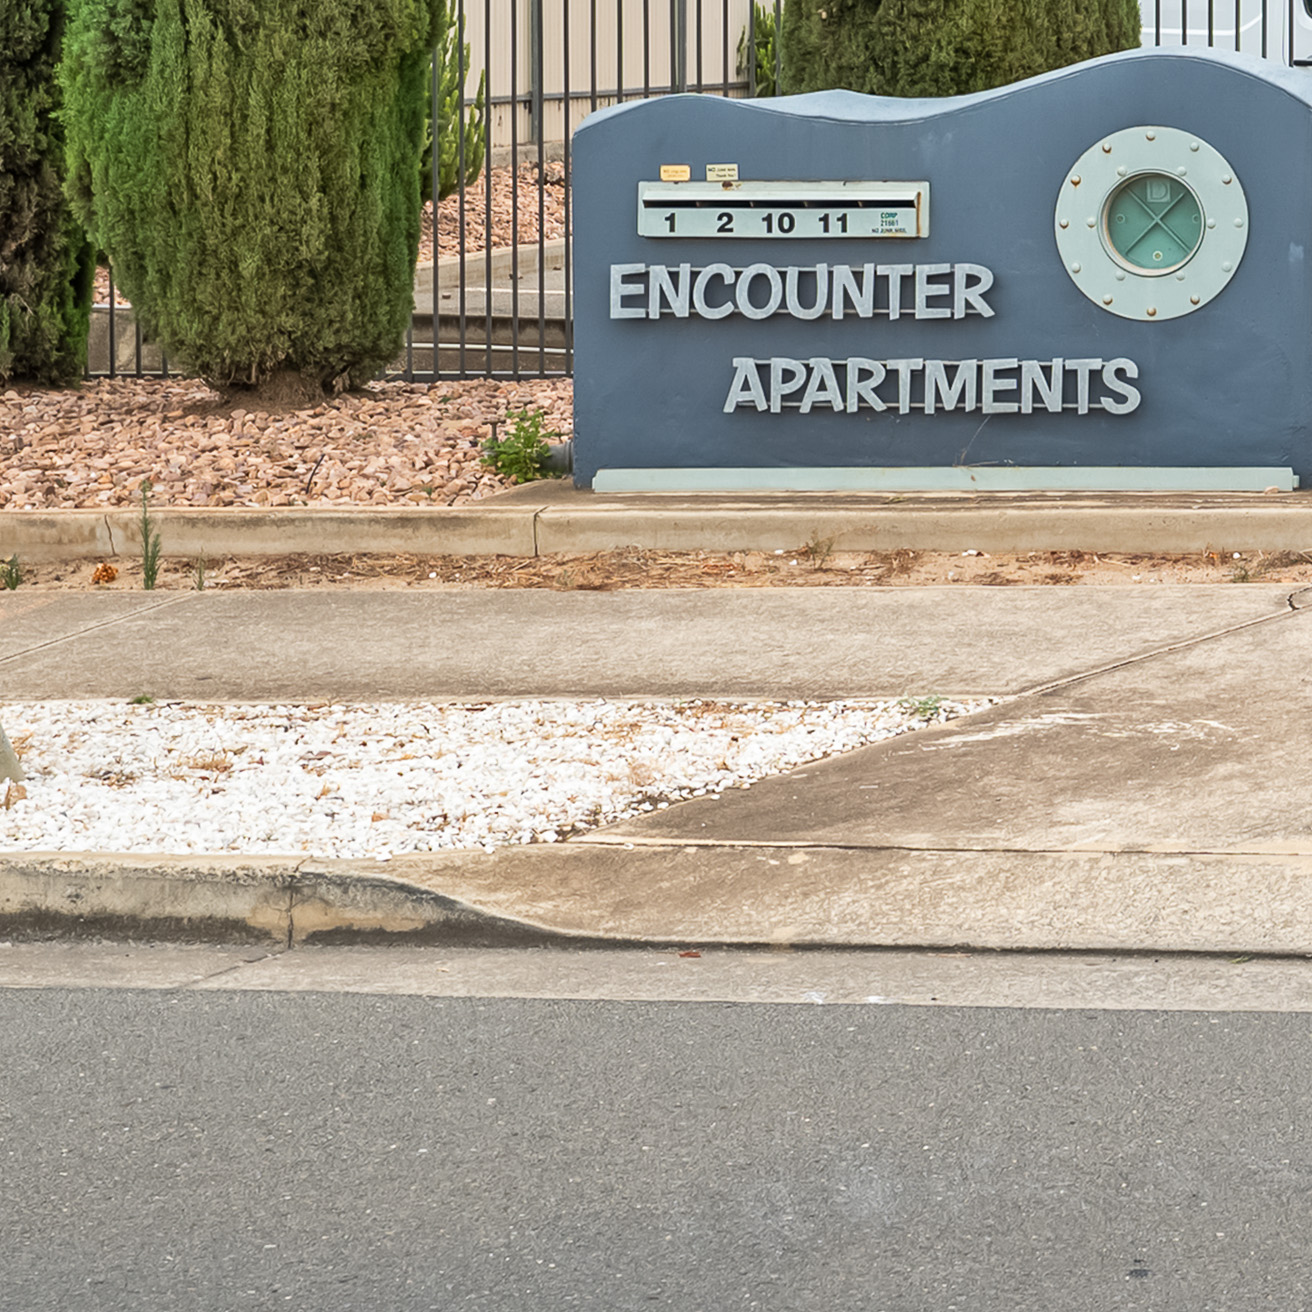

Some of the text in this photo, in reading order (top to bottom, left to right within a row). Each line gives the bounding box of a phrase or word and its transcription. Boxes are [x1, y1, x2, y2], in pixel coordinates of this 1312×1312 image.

[664, 212, 848, 233] 1 2 10 11
[880, 211, 898, 219] CORP
[609, 263, 996, 320] ENCOUNTER
[723, 357, 1142, 415] APARTMENTS
